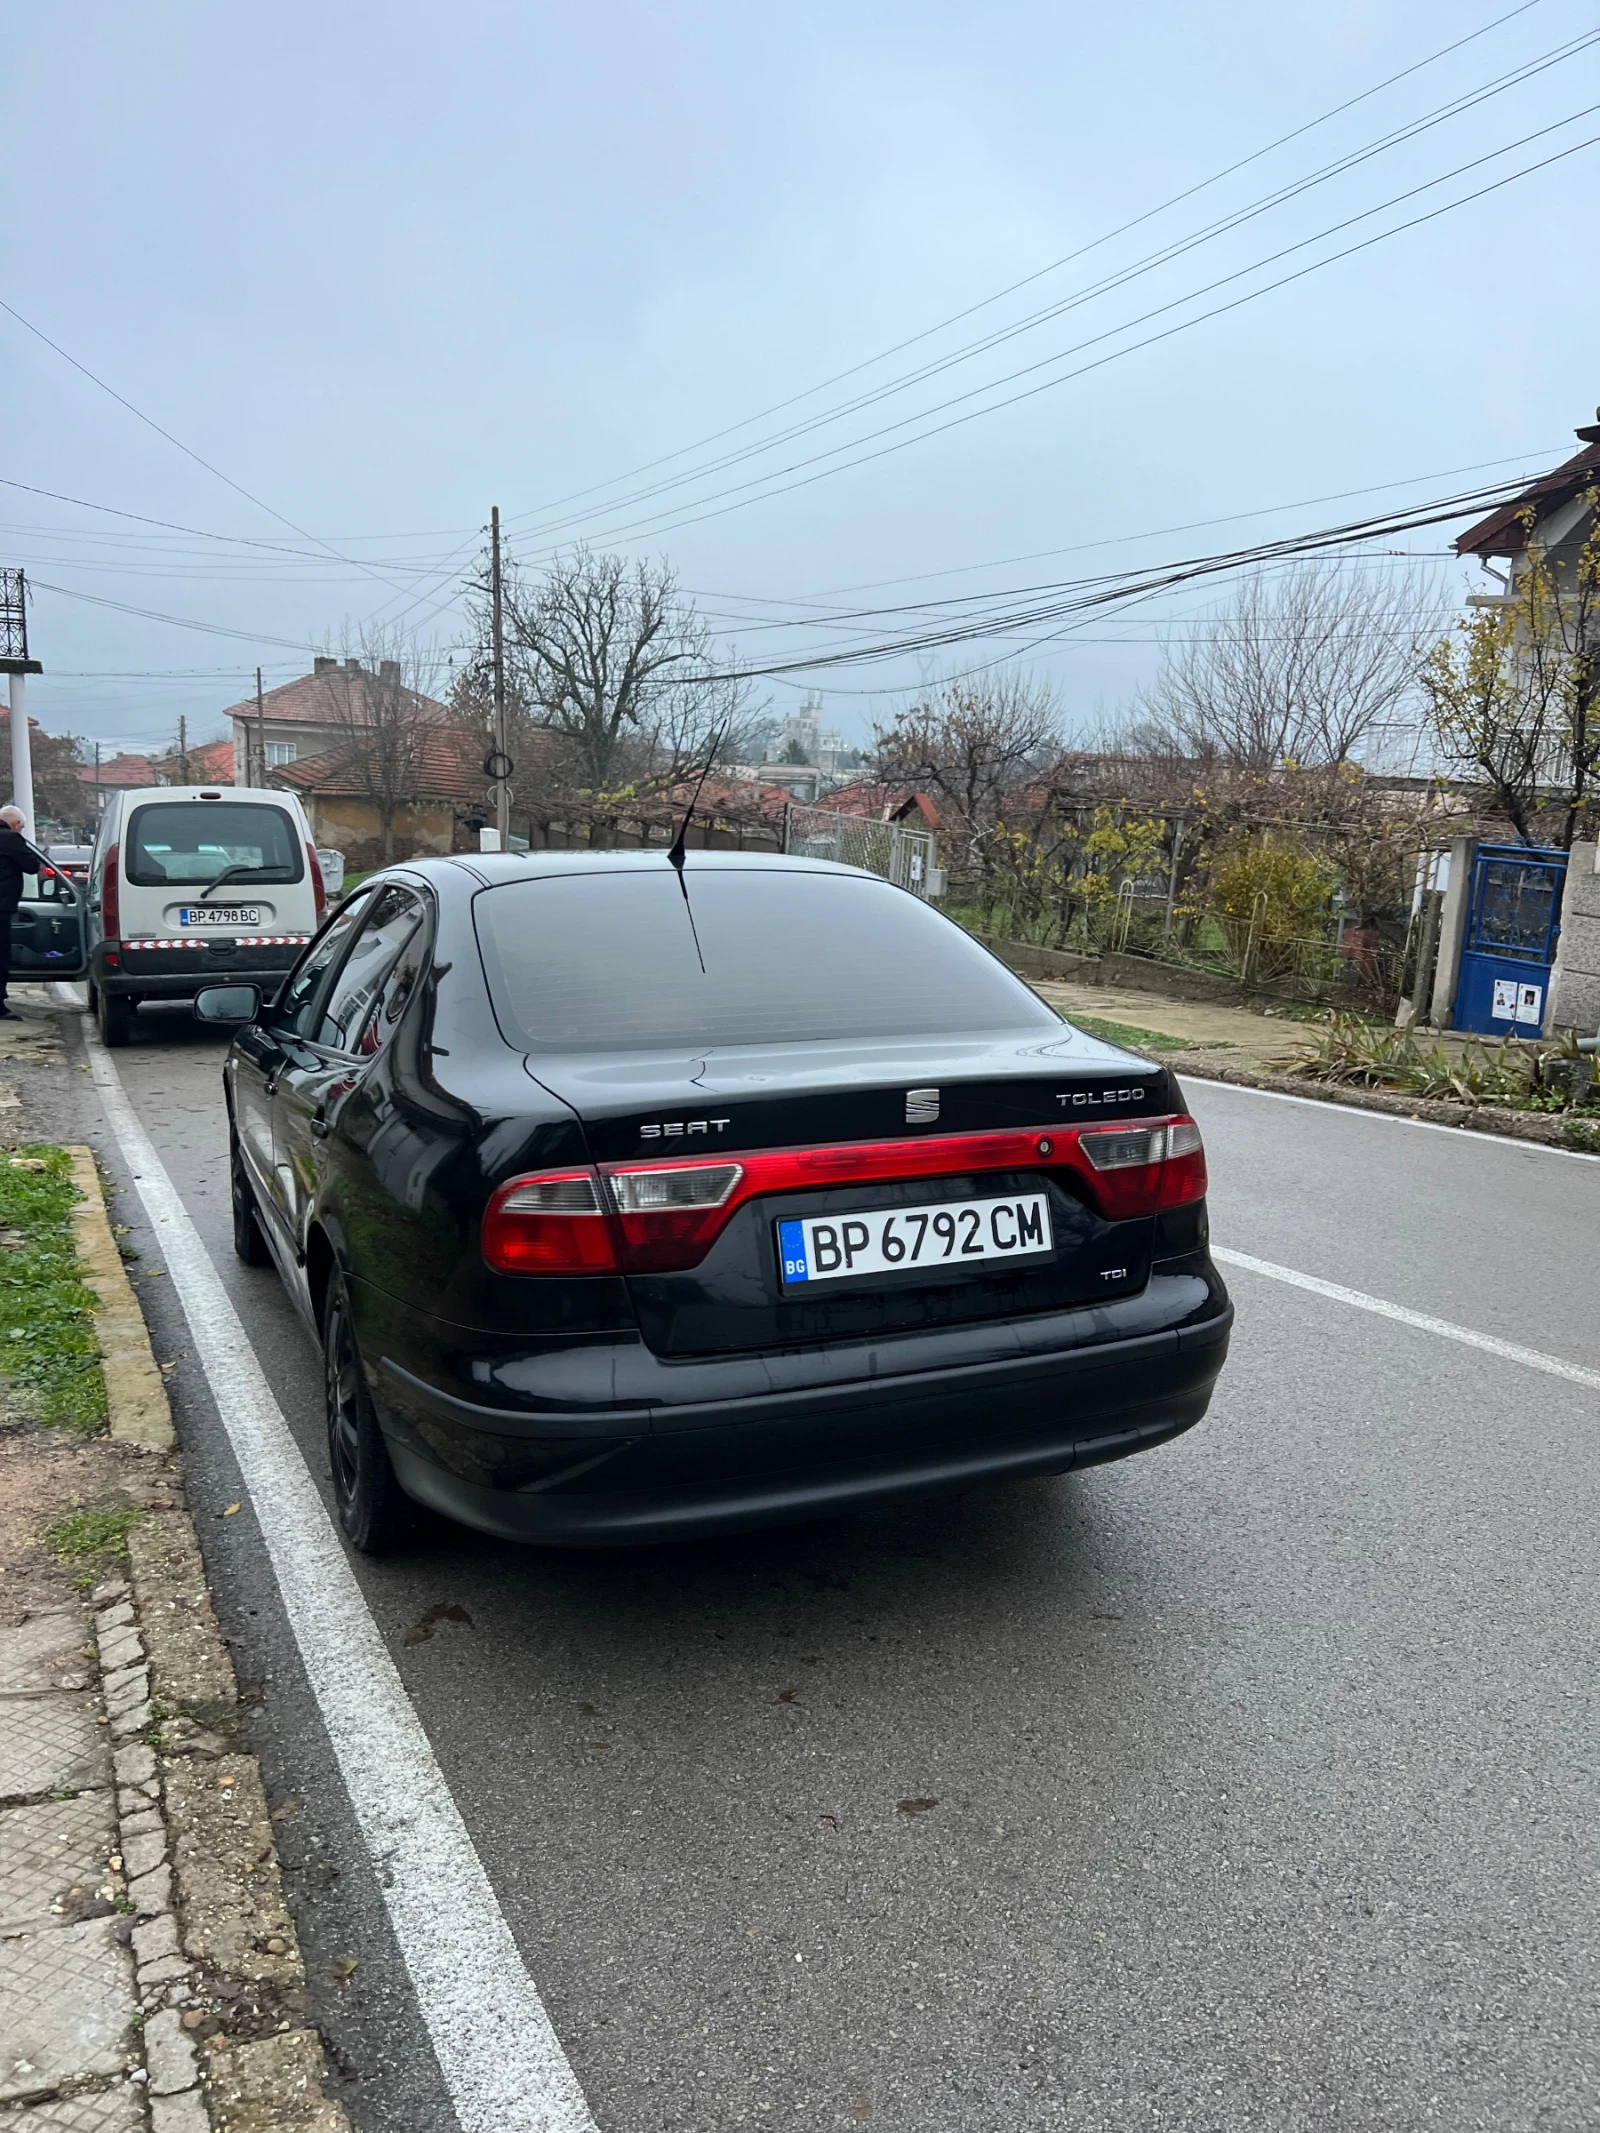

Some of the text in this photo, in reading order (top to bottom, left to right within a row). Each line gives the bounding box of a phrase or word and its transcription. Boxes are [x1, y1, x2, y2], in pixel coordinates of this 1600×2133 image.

[189, 911, 206, 923] BP
[208, 910, 239, 922] 4798
[240, 910, 257, 922] BC
[1055, 1088, 1145, 1106] TOLEDO
[640, 1118, 731, 1139] SEAT
[812, 1201, 1045, 1273] BP 6792 CM
[785, 1259, 806, 1275] BG
[1100, 1268, 1127, 1280] TDI
